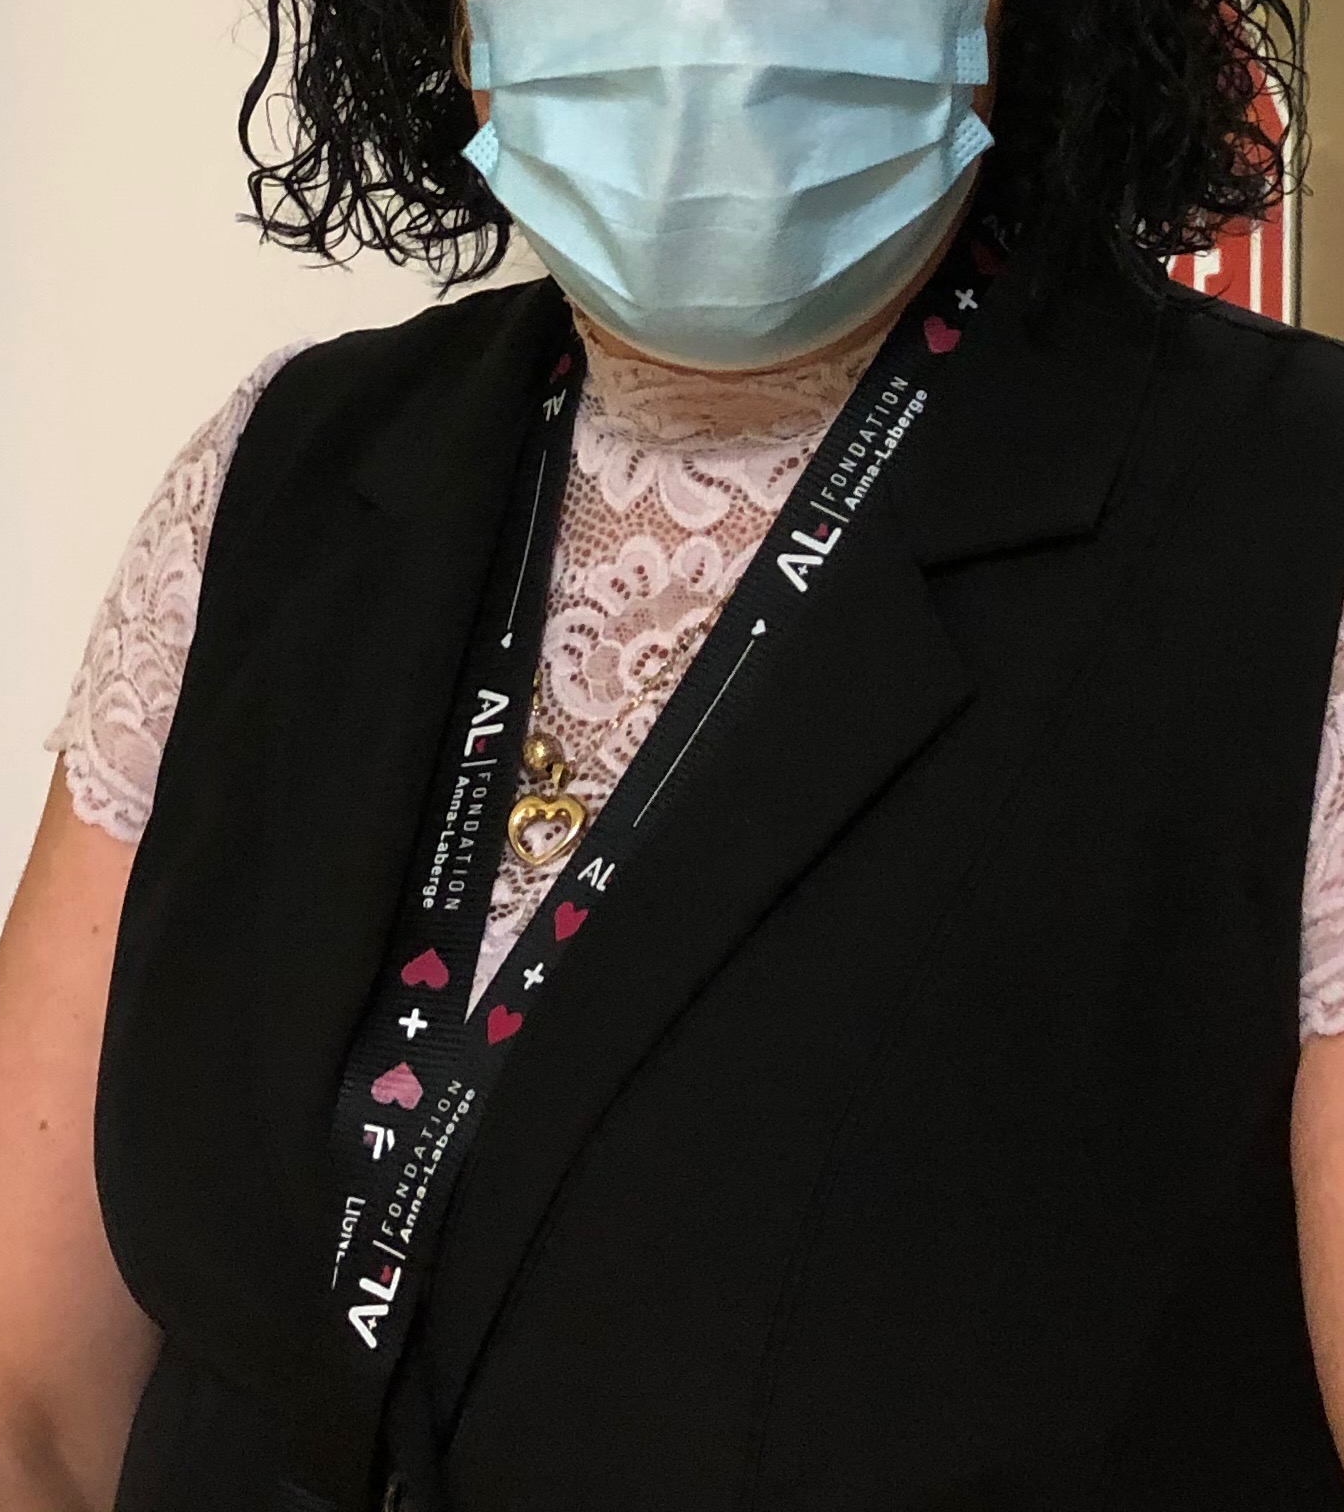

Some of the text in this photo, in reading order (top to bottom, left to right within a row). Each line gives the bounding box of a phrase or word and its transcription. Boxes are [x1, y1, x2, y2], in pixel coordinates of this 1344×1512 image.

[777, 375, 909, 593] AL FONDATION
[844, 388, 929, 512] Anna-Laberge
[422, 774, 471, 910] Anna-Laberge
[444, 688, 510, 911] AL FONDATION
[577, 856, 616, 892] AL
[348, 1079, 462, 1349] AL FONDATION
[399, 1088, 476, 1245] Anna-Laberge
